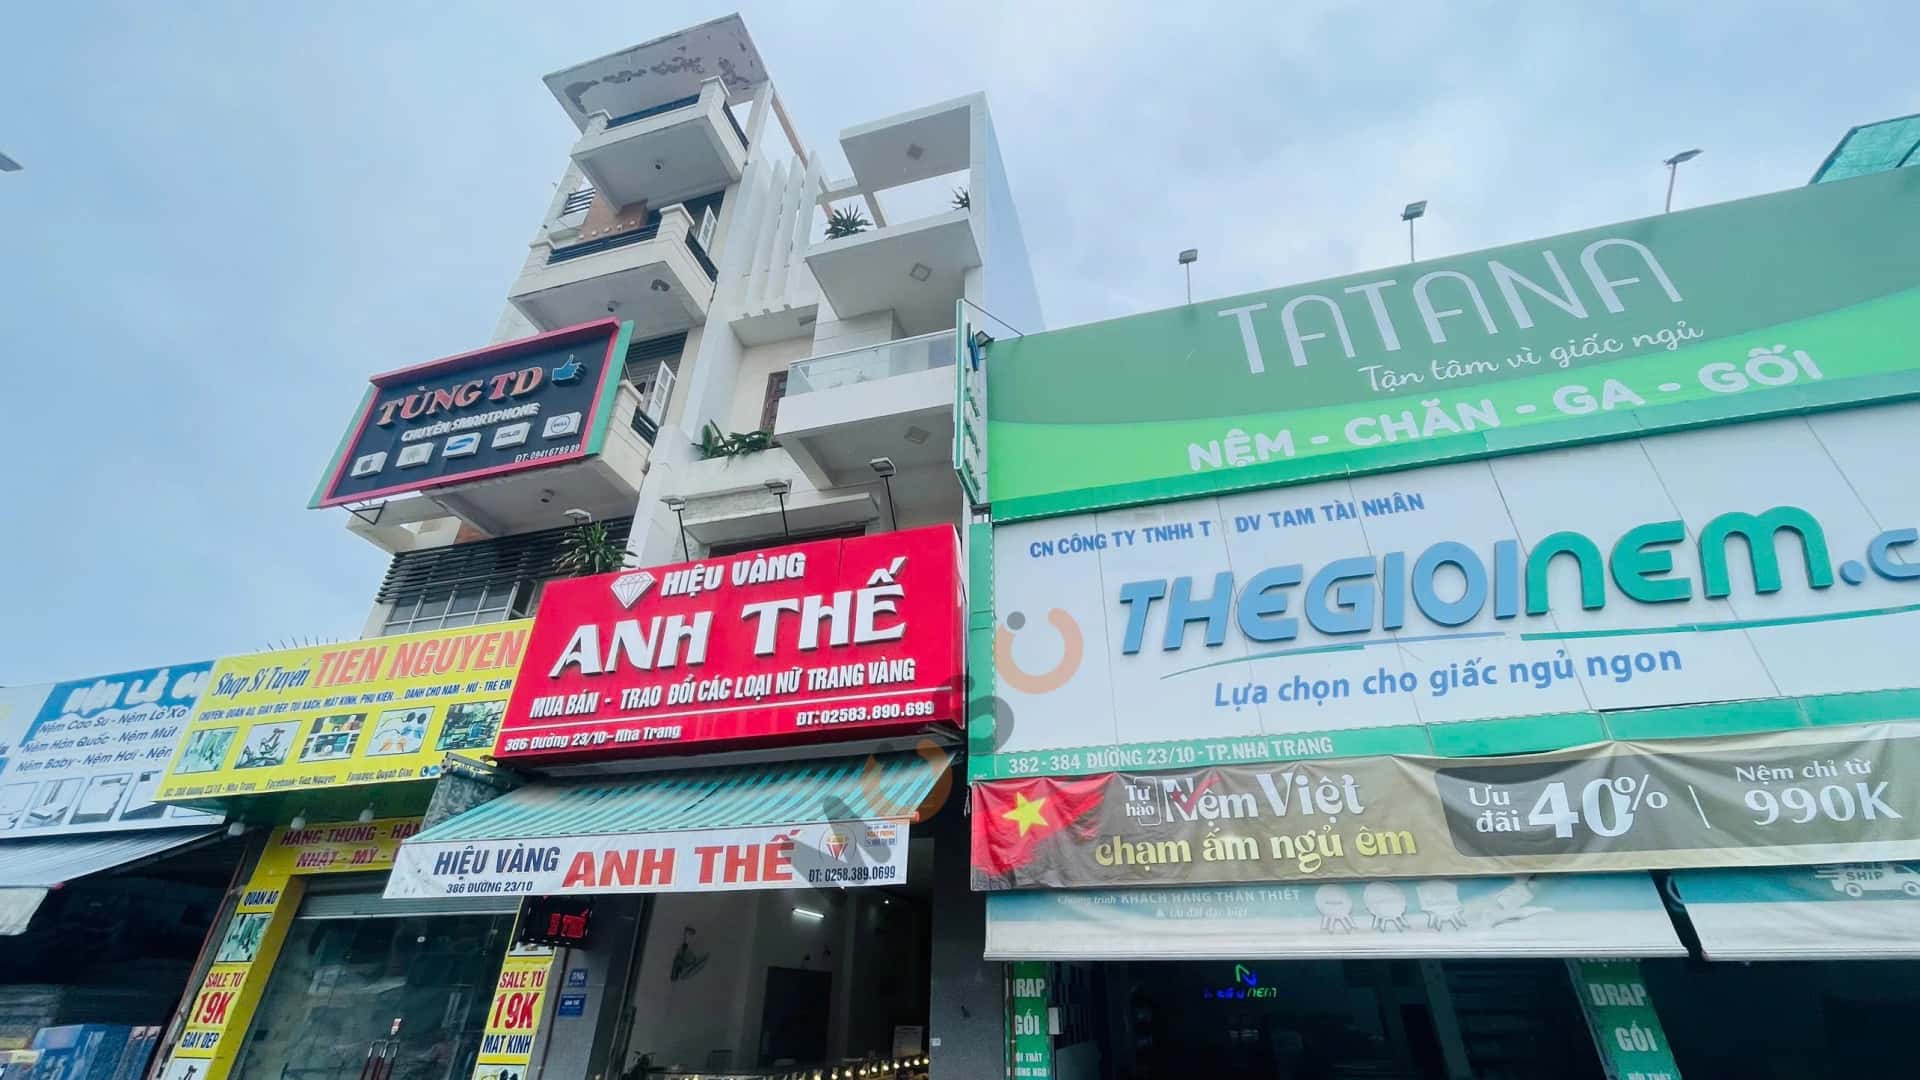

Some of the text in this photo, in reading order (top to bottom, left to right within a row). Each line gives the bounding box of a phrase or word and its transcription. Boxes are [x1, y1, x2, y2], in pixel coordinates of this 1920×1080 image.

[1218, 238, 1683, 375] TATANA
[1431, 358, 1499, 382] tâm
[1509, 344, 1541, 368] vì
[1549, 331, 1624, 369] giấc
[1631, 319, 1704, 353] ngủ
[376, 365, 544, 426] TÙNG TD
[1344, 398, 1501, 446] CHĂN
[1553, 378, 1646, 415] GA
[1698, 343, 1823, 393] GỐI
[1030, 540, 1054, 558] CN
[1058, 532, 1107, 555] CÔNG
[1112, 529, 1136, 548] TY
[1142, 521, 1194, 544] TNHH
[1236, 515, 1262, 534] DV
[1322, 500, 1357, 522] TÀI
[1363, 492, 1426, 518] NHÂN
[660, 552, 806, 599] HIỆU VÀNG
[548, 555, 908, 679] ANH THẾ
[529, 655, 916, 720] MUA BÁN TRAO ĐỔI CÁC LOẠI NỮ TRANG VÀNG
[1215, 648, 1682, 711] Lựa chọn cho giấc ngủ ngon
[504, 738, 529, 752] 386
[643, 724, 682, 740] Trang
[1272, 736, 1334, 757] TRANG
[1735, 757, 1873, 785] Nệm chỉ từ
[1124, 784, 1155, 817] Tự hào
[1256, 772, 1366, 823] Việt
[1469, 786, 1521, 834] Ưu đãi
[1528, 773, 1669, 839] 40%
[1744, 781, 1904, 827] 990K
[432, 845, 488, 880] HIỆU
[495, 843, 561, 875] VÀNG
[562, 848, 676, 888] ANH
[694, 829, 801, 884] THẾ
[1095, 825, 1418, 874] chạm ấm ngủ êm
[503, 880, 533, 893] 23/10
[824, 865, 896, 883] 0258.389.0699
[1846, 871, 1884, 880] SHIP
[205, 972, 231, 988] SALE
[499, 970, 527, 988] SALE
[1588, 983, 1647, 1007] DRAP
[193, 991, 236, 1024] 19K
[492, 992, 541, 1030] 19K
